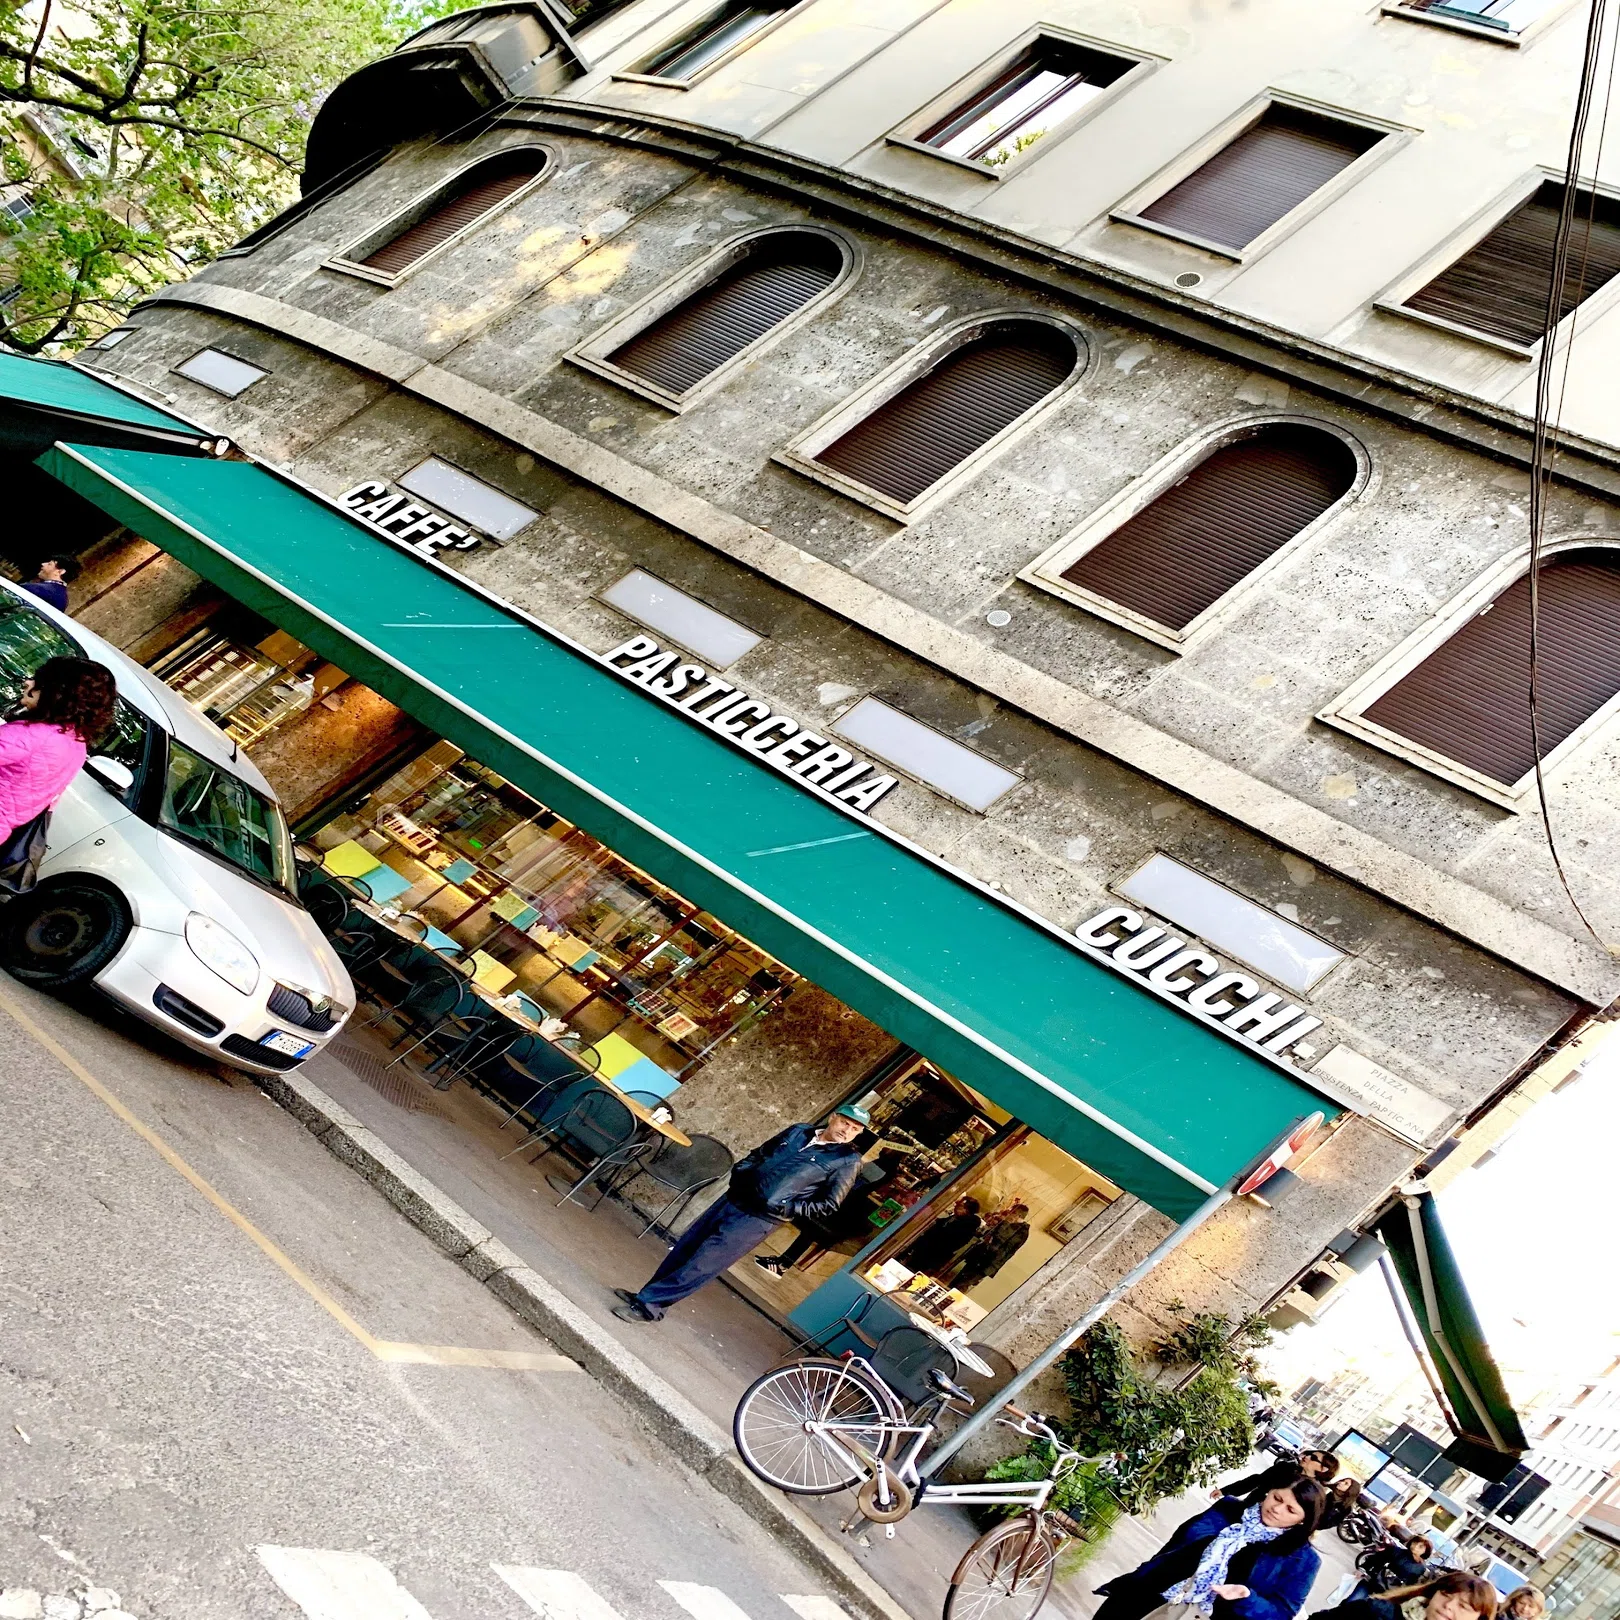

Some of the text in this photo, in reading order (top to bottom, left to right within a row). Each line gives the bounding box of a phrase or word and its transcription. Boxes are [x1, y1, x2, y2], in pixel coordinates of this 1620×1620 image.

[600, 634, 900, 811] PASTICCERIA
[1075, 907, 1324, 1055] CUCCHI
[1313, 1067, 1425, 1136] RESISTENZA PARTIGANA
[1363, 1080, 1394, 1102] DELLA
[1370, 1068, 1409, 1094] PIAZZA
